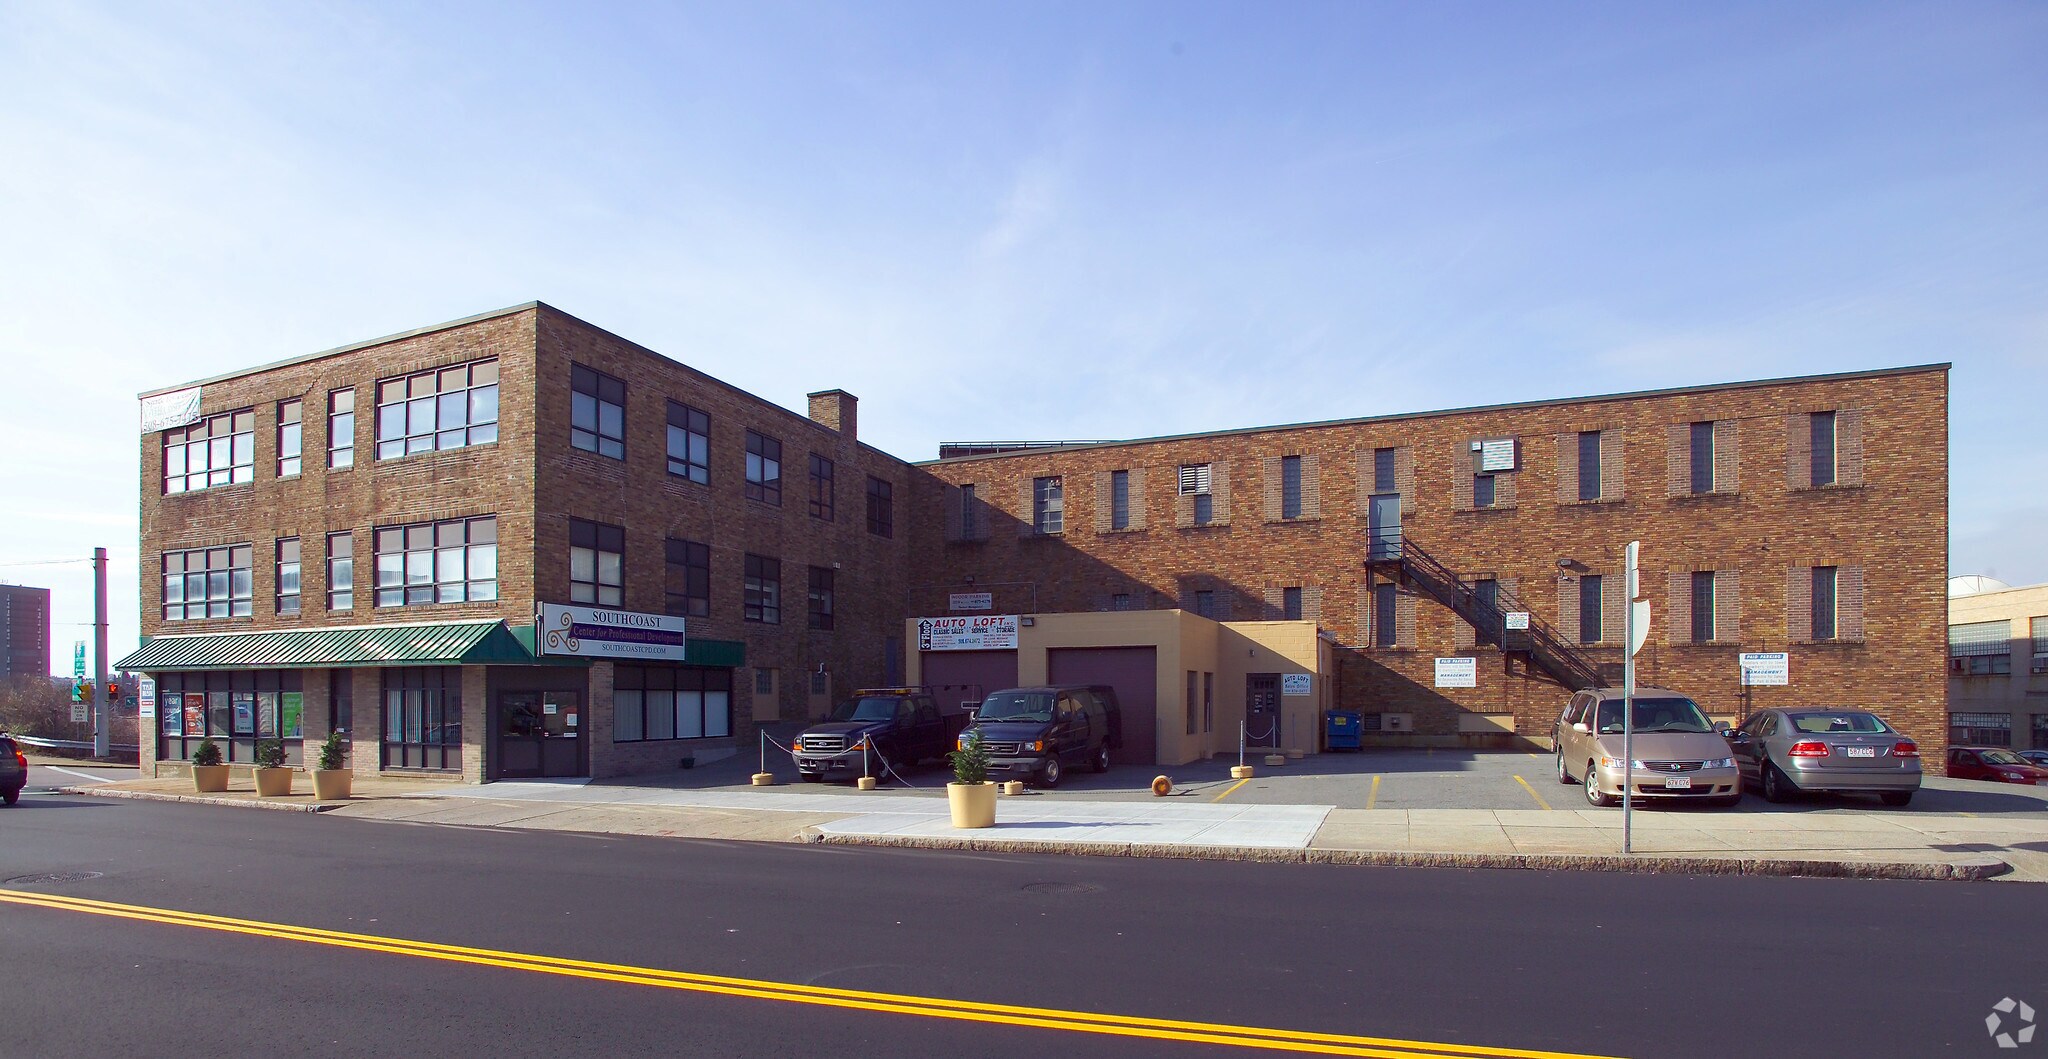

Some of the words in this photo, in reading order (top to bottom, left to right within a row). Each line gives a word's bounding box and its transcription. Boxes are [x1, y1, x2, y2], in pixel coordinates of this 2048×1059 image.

[592, 611, 662, 628] SOUTHCOAST
[934, 619, 966, 628] AUTO
[973, 617, 1006, 627] LOFT
[573, 625, 595, 637] Center
[596, 627, 607, 639] for
[608, 628, 646, 641] Professional
[647, 631, 683, 645] Development
[922, 621, 930, 638] Floor
[933, 627, 950, 635] CLASSIC
[951, 627, 964, 635] SALES
[971, 626, 989, 634] SERVICE
[996, 625, 1015, 634] STORAGE
[602, 643, 667, 655] SOUTHCOASTCPD.COM
[1284, 675, 1296, 683] AUTO
[1297, 675, 1309, 683] LOFT
[165, 697, 178, 707] year
